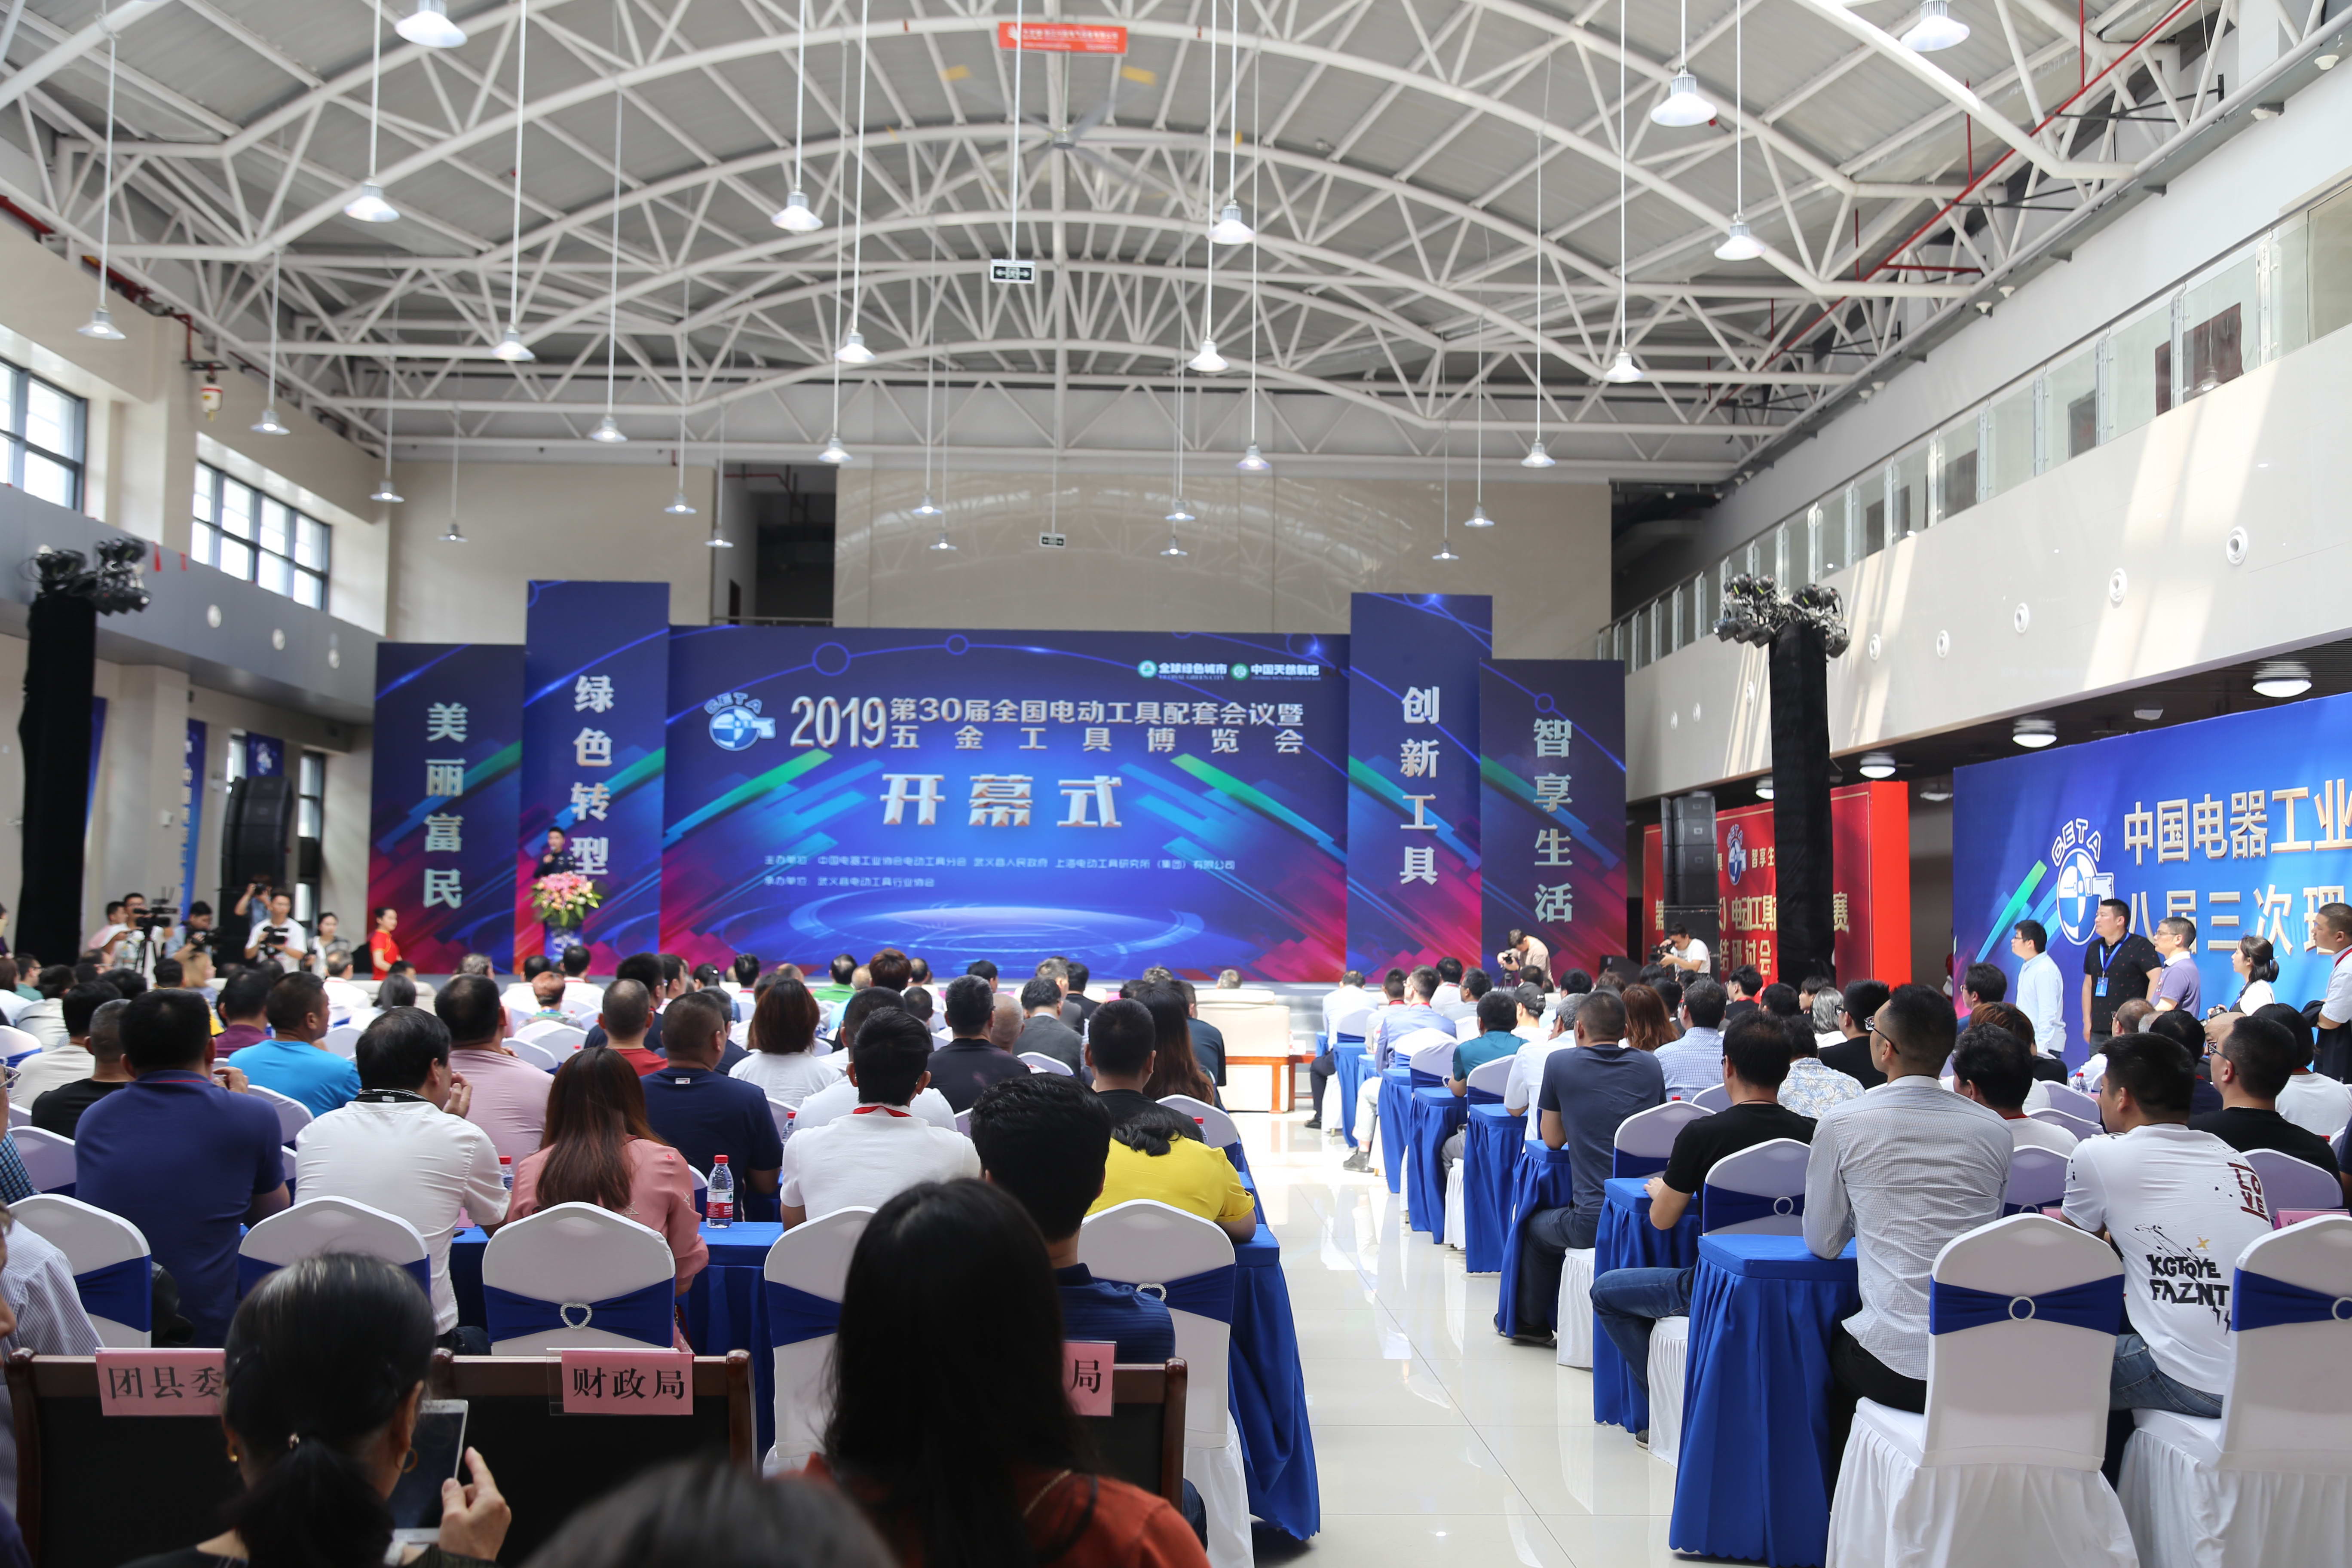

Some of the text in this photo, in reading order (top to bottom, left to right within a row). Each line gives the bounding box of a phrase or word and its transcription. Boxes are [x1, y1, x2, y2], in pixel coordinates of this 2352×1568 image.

[1251, 664, 1319, 676] 中国天然氧吧
[790, 696, 887, 749] 2019
[890, 698, 1304, 727] 第30届全国电动工具配套会议暨
[890, 725, 1304, 753] 五金工具博览会
[570, 674, 614, 875] 绿色转型
[880, 774, 1122, 827] 开幕式
[1399, 686, 1440, 885] 创新工具
[423, 702, 469, 909] 美丽富民
[1534, 718, 1573, 923] 智享生活
[2124, 778, 2352, 866] 中国电器工业
[108, 1366, 221, 1399] 团县委
[573, 1367, 685, 1400] 财政局
[1069, 1359, 1101, 1394] 局
